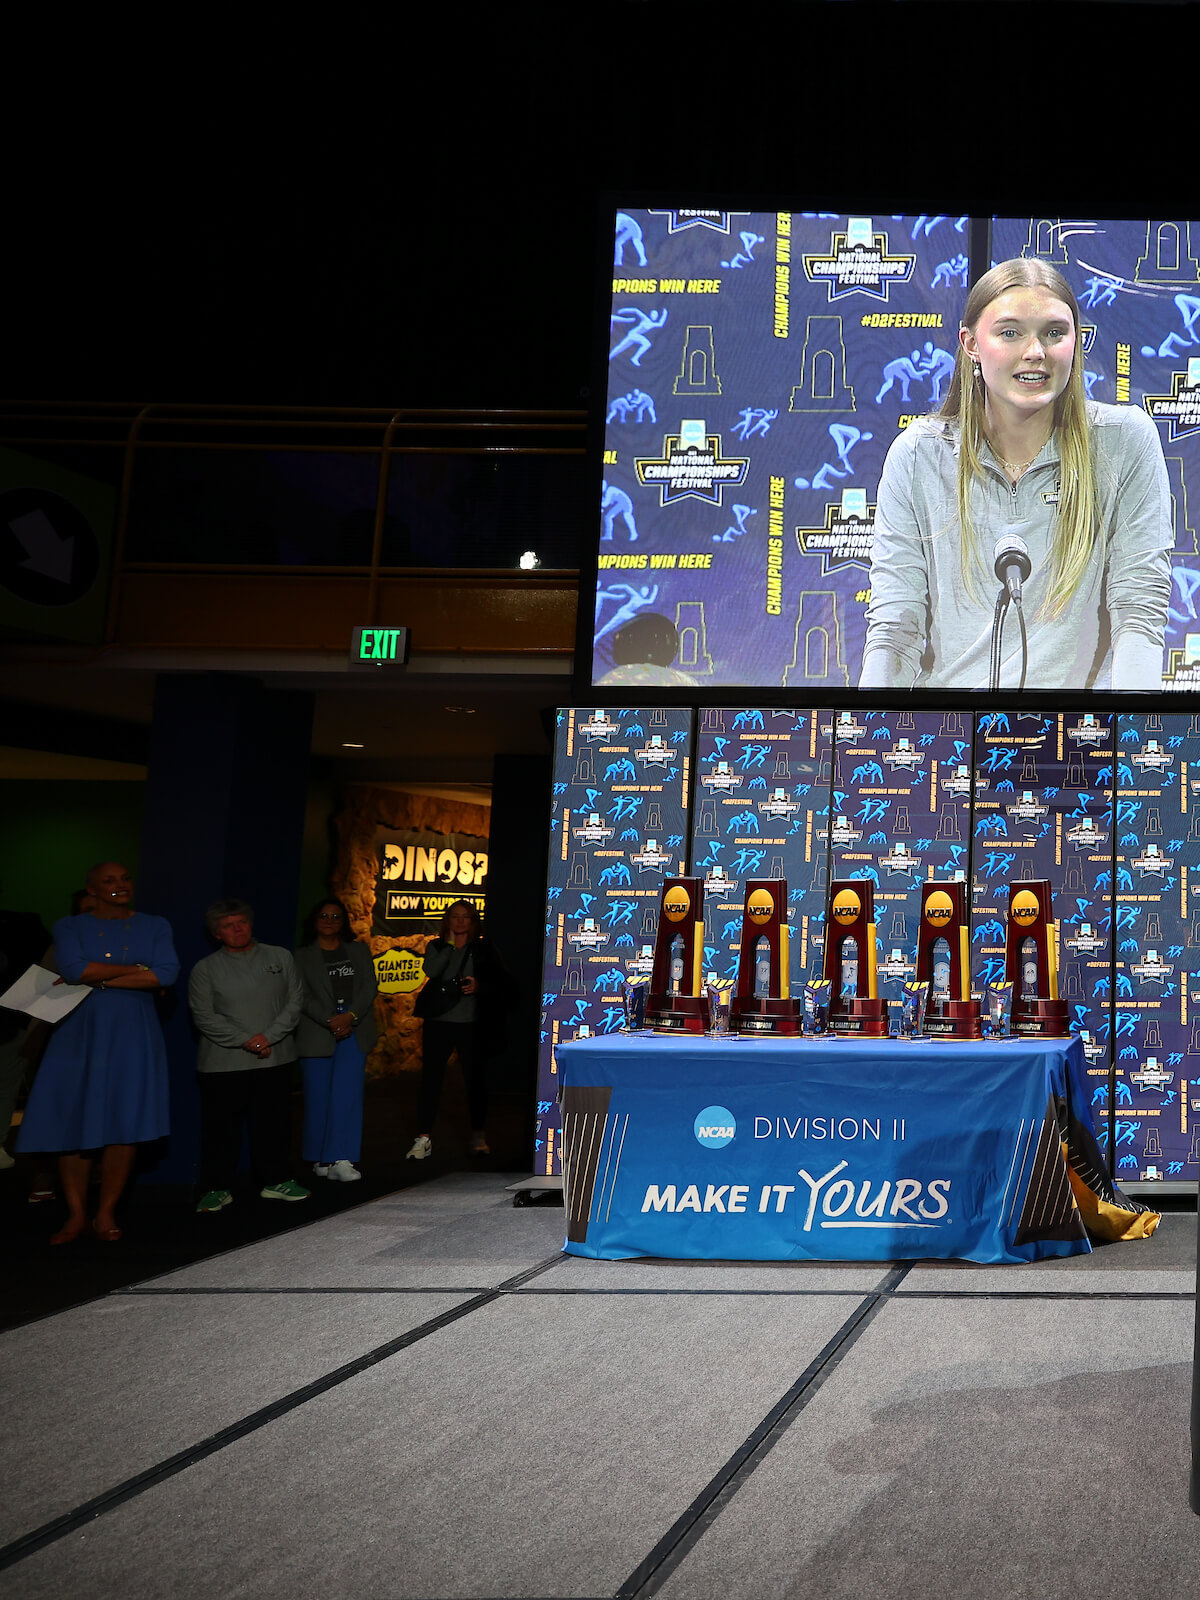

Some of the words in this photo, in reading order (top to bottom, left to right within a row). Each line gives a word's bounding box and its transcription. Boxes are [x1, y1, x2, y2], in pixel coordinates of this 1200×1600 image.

[776, 238, 790, 262] WIN
[838, 252, 882, 262] NATIONAL
[813, 262, 906, 274] CHAMPIONSHIPS
[838, 274, 880, 284] FESTIVAL
[659, 280, 685, 294] WIN
[687, 280, 721, 294] HERE
[774, 265, 790, 338] CHAMPIONS
[861, 314, 944, 328] #D2FESTIVAL
[1116, 342, 1130, 376] HERE
[1116, 376, 1130, 402] WIN
[670, 455, 714, 465] NATIONAL
[644, 466, 740, 478] CHAMPIONSHIPS
[671, 478, 713, 488] FESTIVAL
[770, 476, 784, 509] HERE
[769, 510, 784, 536] WIN
[650, 554, 677, 569] WIN
[678, 554, 713, 568] HERE
[767, 538, 783, 615] CHAMPIONS
[359, 629, 400, 660] EXIT
[391, 896, 420, 910] NOW
[422, 896, 462, 911] YOU'
[665, 903, 688, 914] NCAA
[749, 905, 772, 916] NCAA
[834, 907, 858, 916] NCAA
[927, 908, 951, 918] NCAA
[1013, 907, 1038, 917] NCAA
[378, 960, 413, 972] GIANTS
[378, 971, 419, 983] JURASSIC
[697, 1126, 736, 1138] NCAA
[753, 1116, 882, 1140] DIVISION
[892, 1117, 906, 1141] II
[641, 1184, 749, 1214] MAKE
[758, 1186, 796, 1214] IT
[798, 1159, 952, 1232] YOURS
